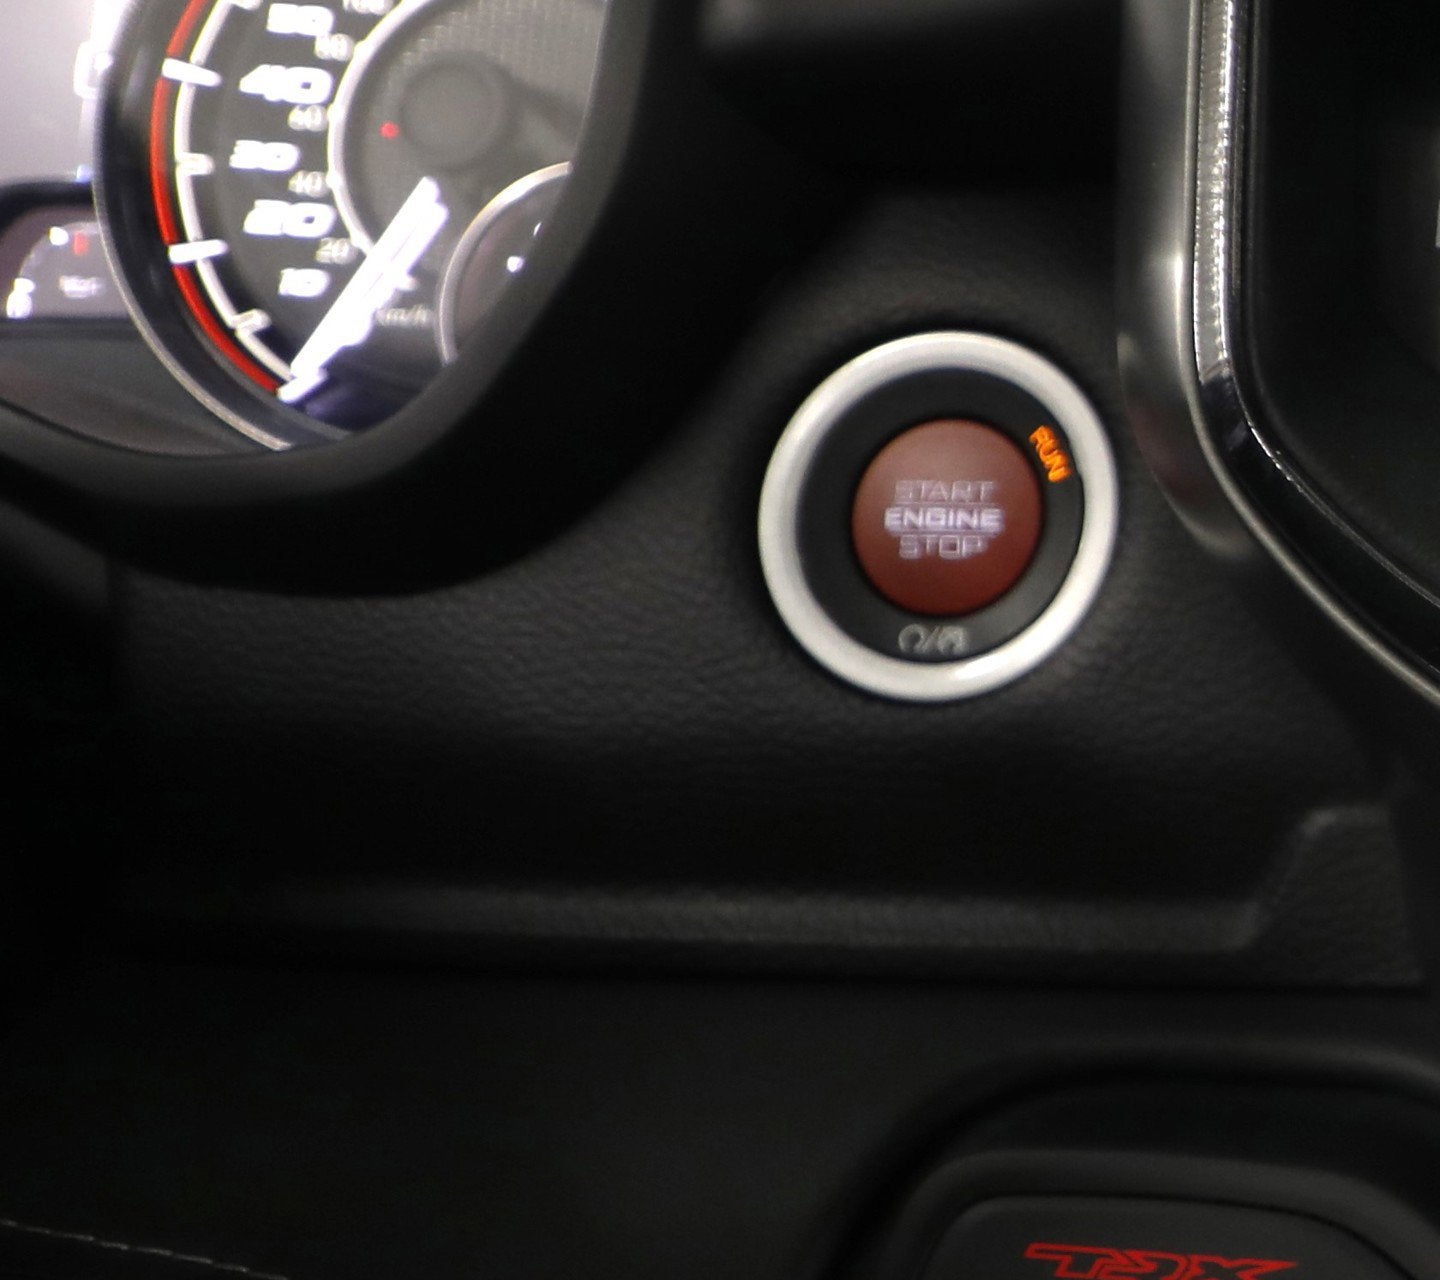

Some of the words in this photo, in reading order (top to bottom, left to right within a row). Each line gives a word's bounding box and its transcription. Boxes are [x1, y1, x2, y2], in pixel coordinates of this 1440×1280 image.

[1029, 425, 1072, 483] RUN
[895, 480, 994, 500] START
[884, 507, 1005, 533] ENGINE
[899, 535, 987, 559] STOP
